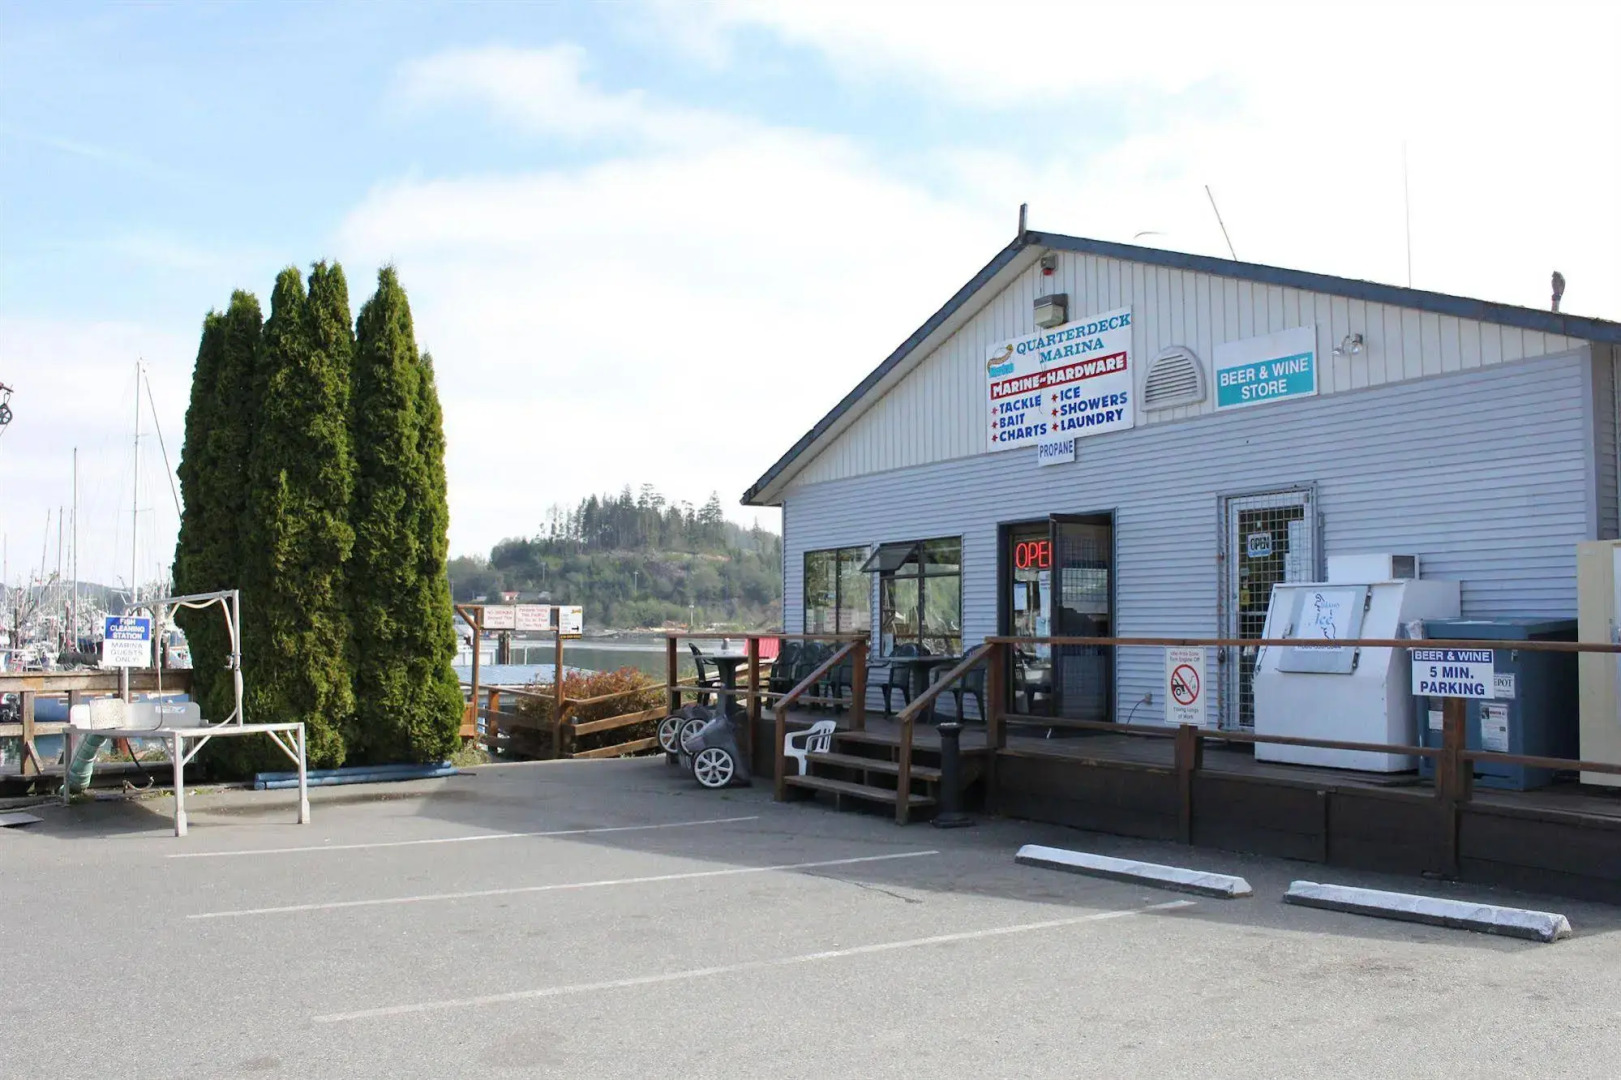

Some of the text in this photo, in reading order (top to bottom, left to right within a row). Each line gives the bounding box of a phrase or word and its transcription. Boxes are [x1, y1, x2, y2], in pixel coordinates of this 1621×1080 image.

[1016, 313, 1131, 355] QUARTERDECK
[1040, 337, 1105, 364] MARINA
[1221, 357, 1309, 387] BEER & WINE
[1061, 386, 1080, 401] ICE
[1242, 379, 1287, 399] STORE
[999, 395, 1041, 414] TACKLE
[1060, 391, 1128, 416] SHOWERS
[1000, 413, 1025, 428] BAIT
[1061, 408, 1123, 431] LAUNDRY
[1000, 423, 1047, 442] CHARTS
[1040, 440, 1073, 457] PROPANE
[1250, 536, 1270, 550] OPEN
[1415, 650, 1490, 662] BEER & WINE
[1430, 666, 1474, 679] 5 MIN.
[1420, 681, 1485, 695] PARKING
